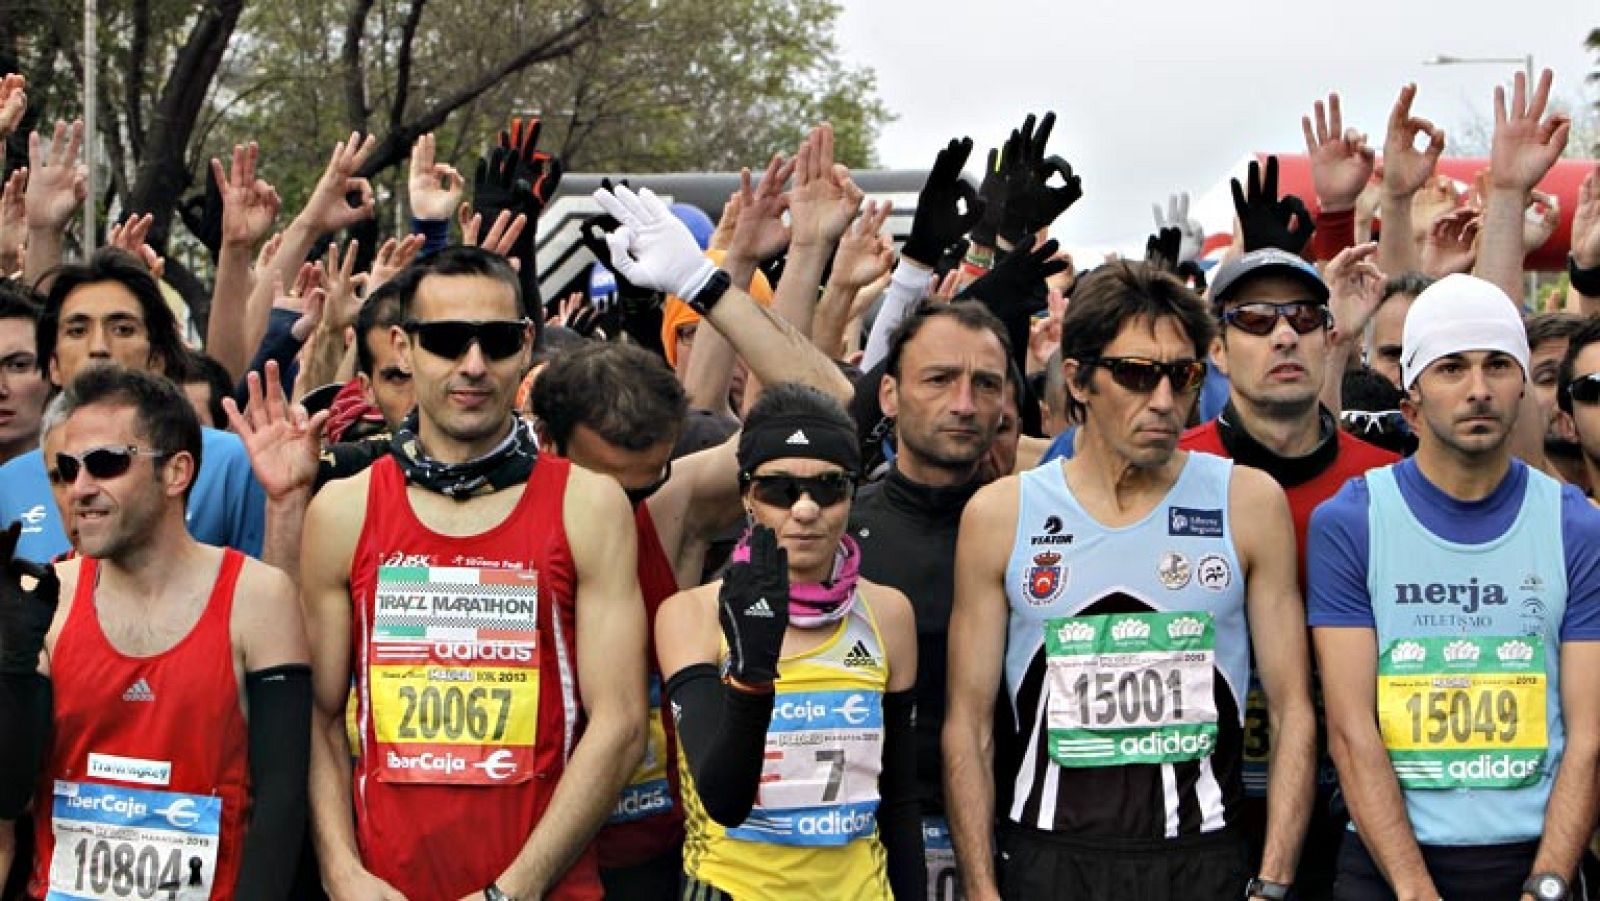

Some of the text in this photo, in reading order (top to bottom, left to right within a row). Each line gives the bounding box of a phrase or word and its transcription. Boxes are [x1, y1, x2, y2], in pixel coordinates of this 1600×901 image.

[1394, 577, 1508, 613] nerja
[1414, 614, 1493, 627] ATLETISMO
[499, 672, 527, 683] 2013
[398, 685, 512, 741] 20067
[772, 700, 826, 722] rCaja
[1074, 669, 1183, 725] 15001
[1406, 690, 1518, 744] 15049
[1120, 732, 1211, 756] adidas
[815, 751, 844, 802] 7
[1449, 755, 1539, 779] adidas
[75, 838, 182, 901] 10804
